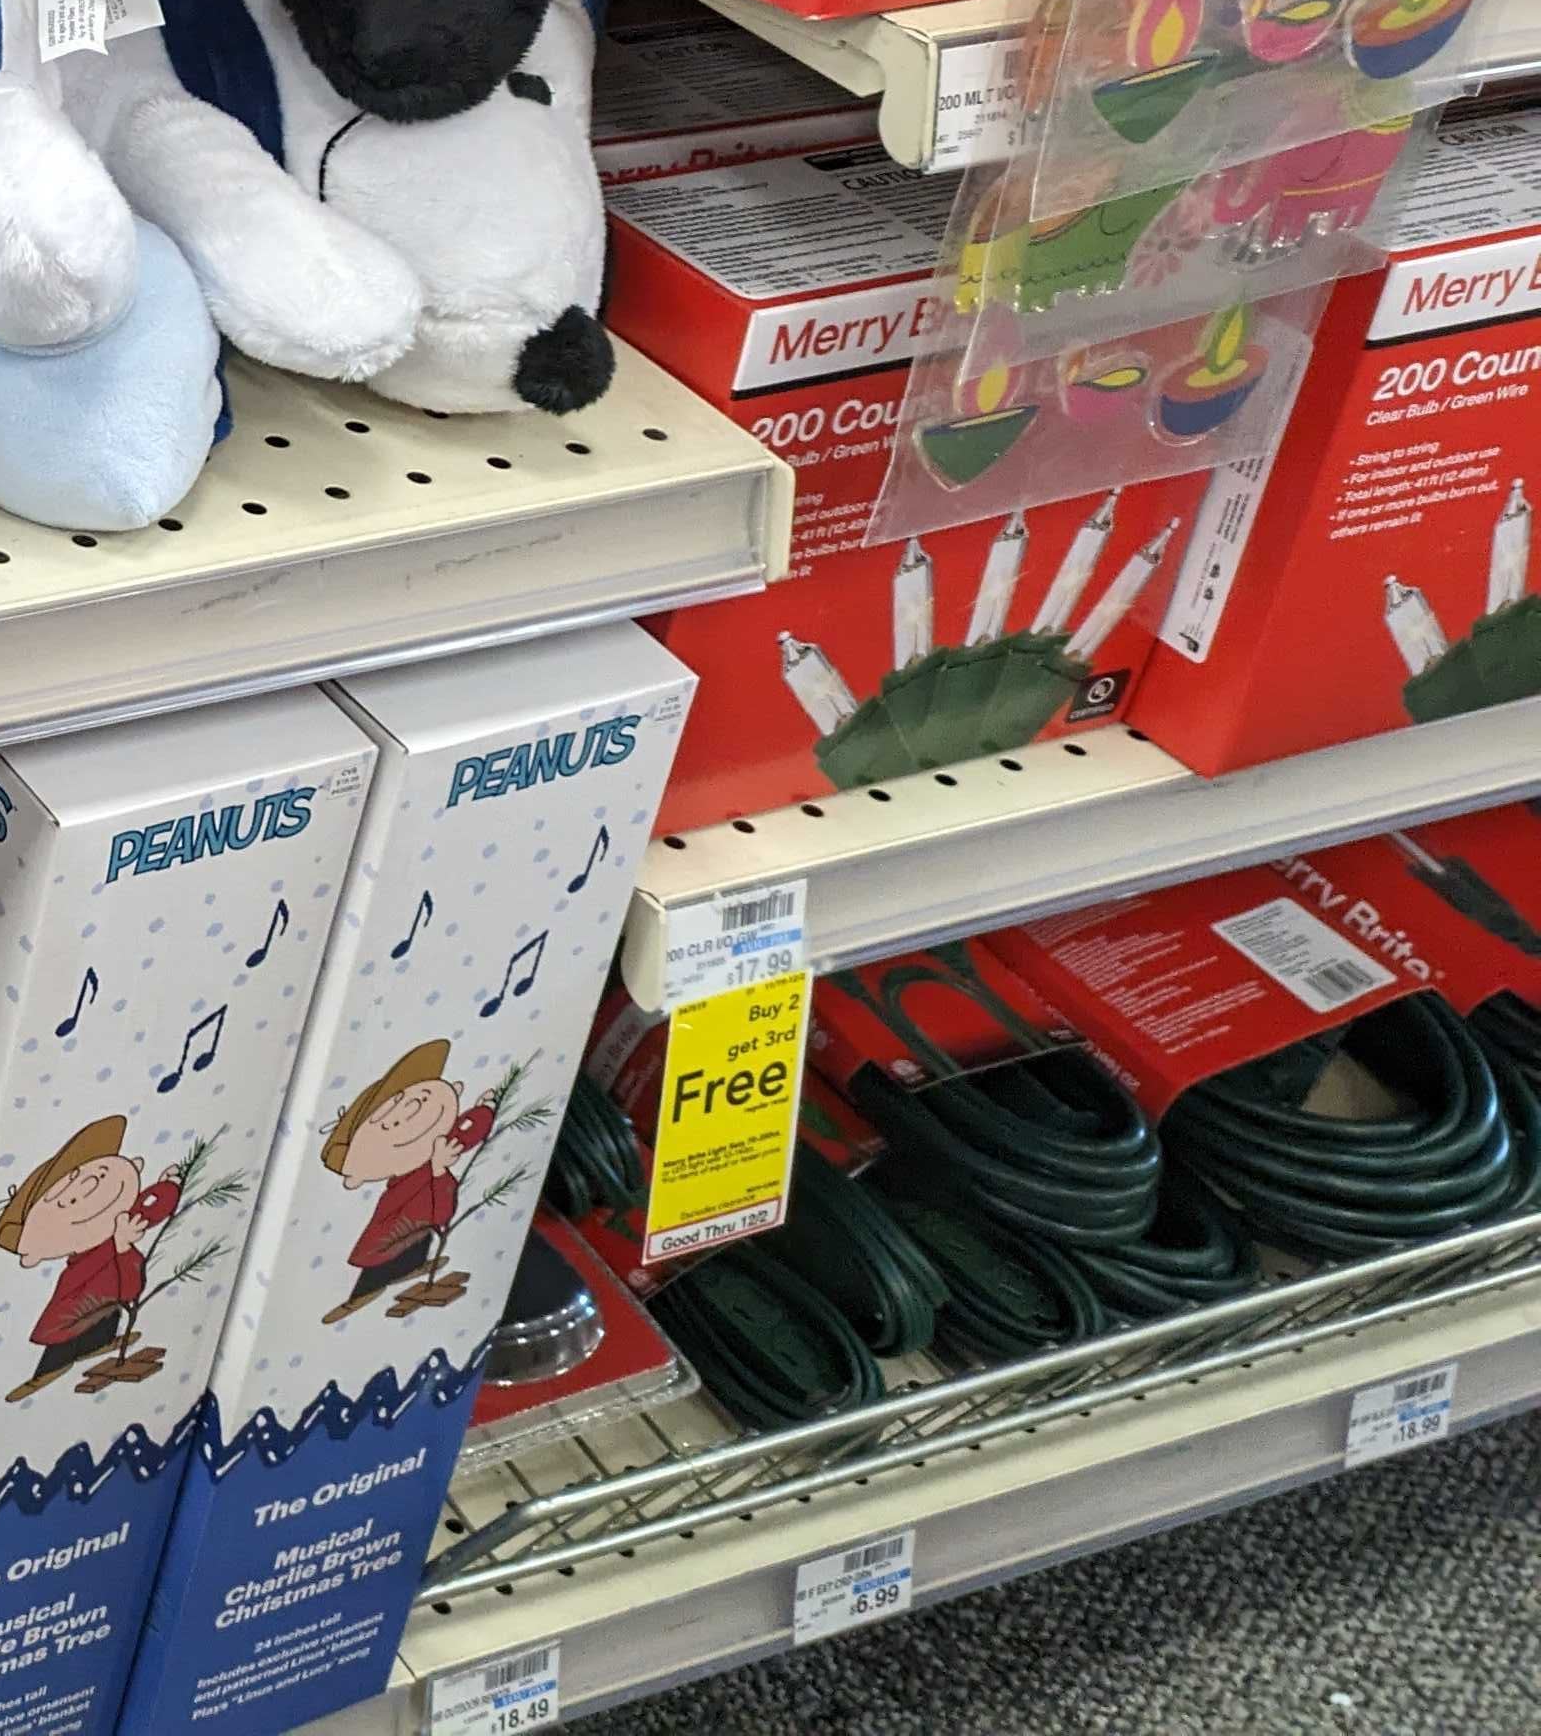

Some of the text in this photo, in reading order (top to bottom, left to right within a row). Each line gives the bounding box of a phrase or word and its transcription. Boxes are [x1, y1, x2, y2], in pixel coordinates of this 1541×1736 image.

[1403, 265, 1527, 317] Merry
[769, 311, 905, 365] Merry
[1373, 345, 1541, 402] 200 Coun
[1365, 383, 1530, 426] Clear Bulb Green Wire
[445, 714, 642, 810] PEANUTS
[105, 786, 317, 884] PEANUTS
[1343, 898, 1431, 981] Brite
[727, 948, 793, 986] $17.99
[749, 993, 800, 1022] Buy 2
[727, 1023, 796, 1062] get 3rd
[672, 1060, 788, 1124] Free
[661, 1209, 769, 1252] Good Thru 12/2
[254, 1447, 427, 1527] The Original
[6, 1521, 131, 1582] Original
[224, 1531, 401, 1606] Charlie Brown
[274, 1518, 375, 1570] Musical
[215, 1549, 403, 1630] Christmas Tree
[22, 1605, 109, 1647] Brown
[54, 1623, 112, 1655] Tree
